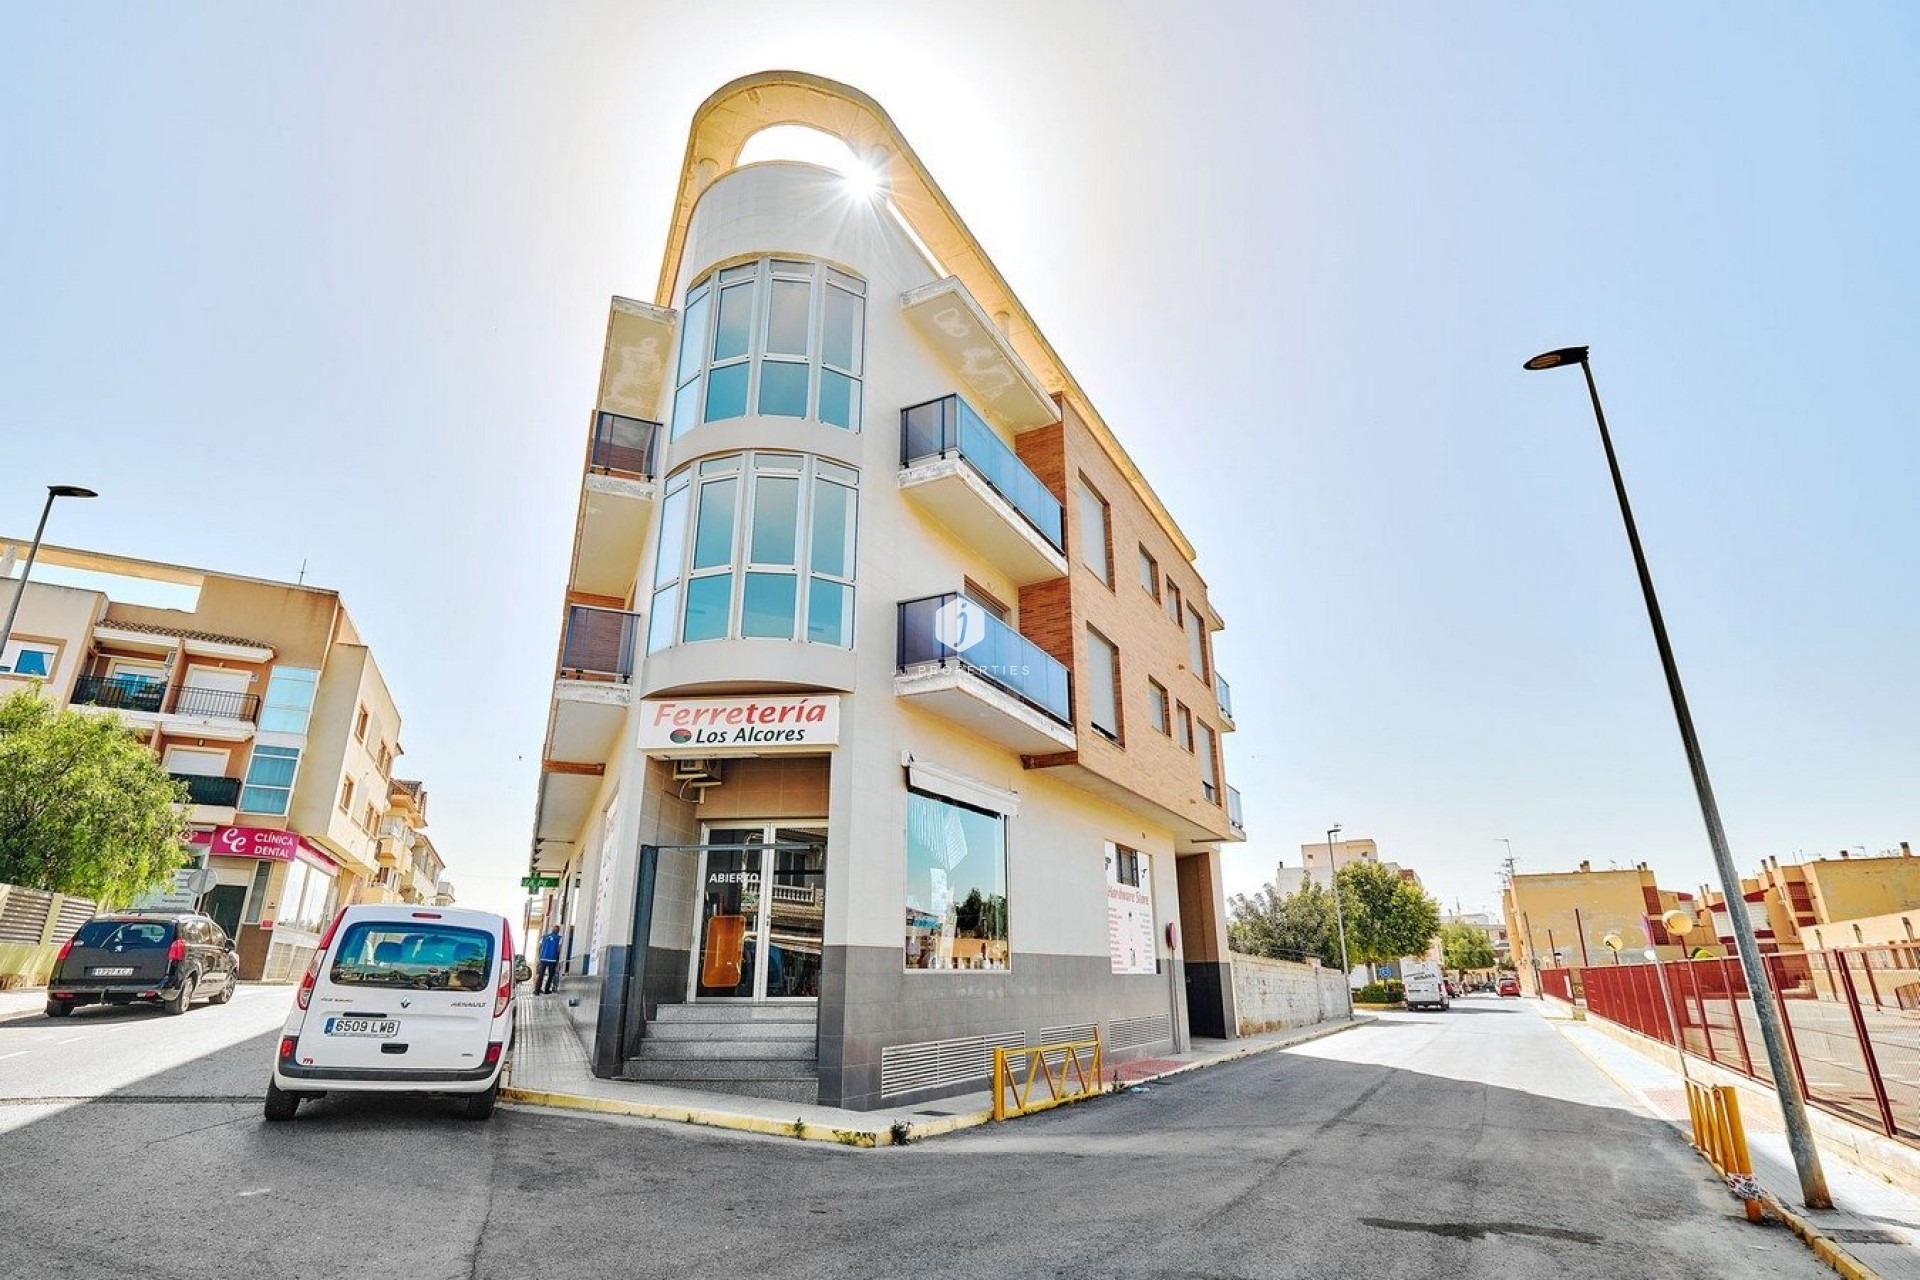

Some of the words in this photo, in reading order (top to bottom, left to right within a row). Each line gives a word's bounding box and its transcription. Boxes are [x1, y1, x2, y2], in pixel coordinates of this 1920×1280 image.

[653, 698, 827, 727] Ferretería
[695, 728, 728, 744] Los
[732, 727, 806, 743] Alcores
[254, 832, 293, 846] CLÍNICA
[254, 845, 290, 858] DENTAL
[709, 872, 759, 883] ABIERTO
[335, 1020, 368, 1032] 6509
[370, 1021, 396, 1033] LWB
